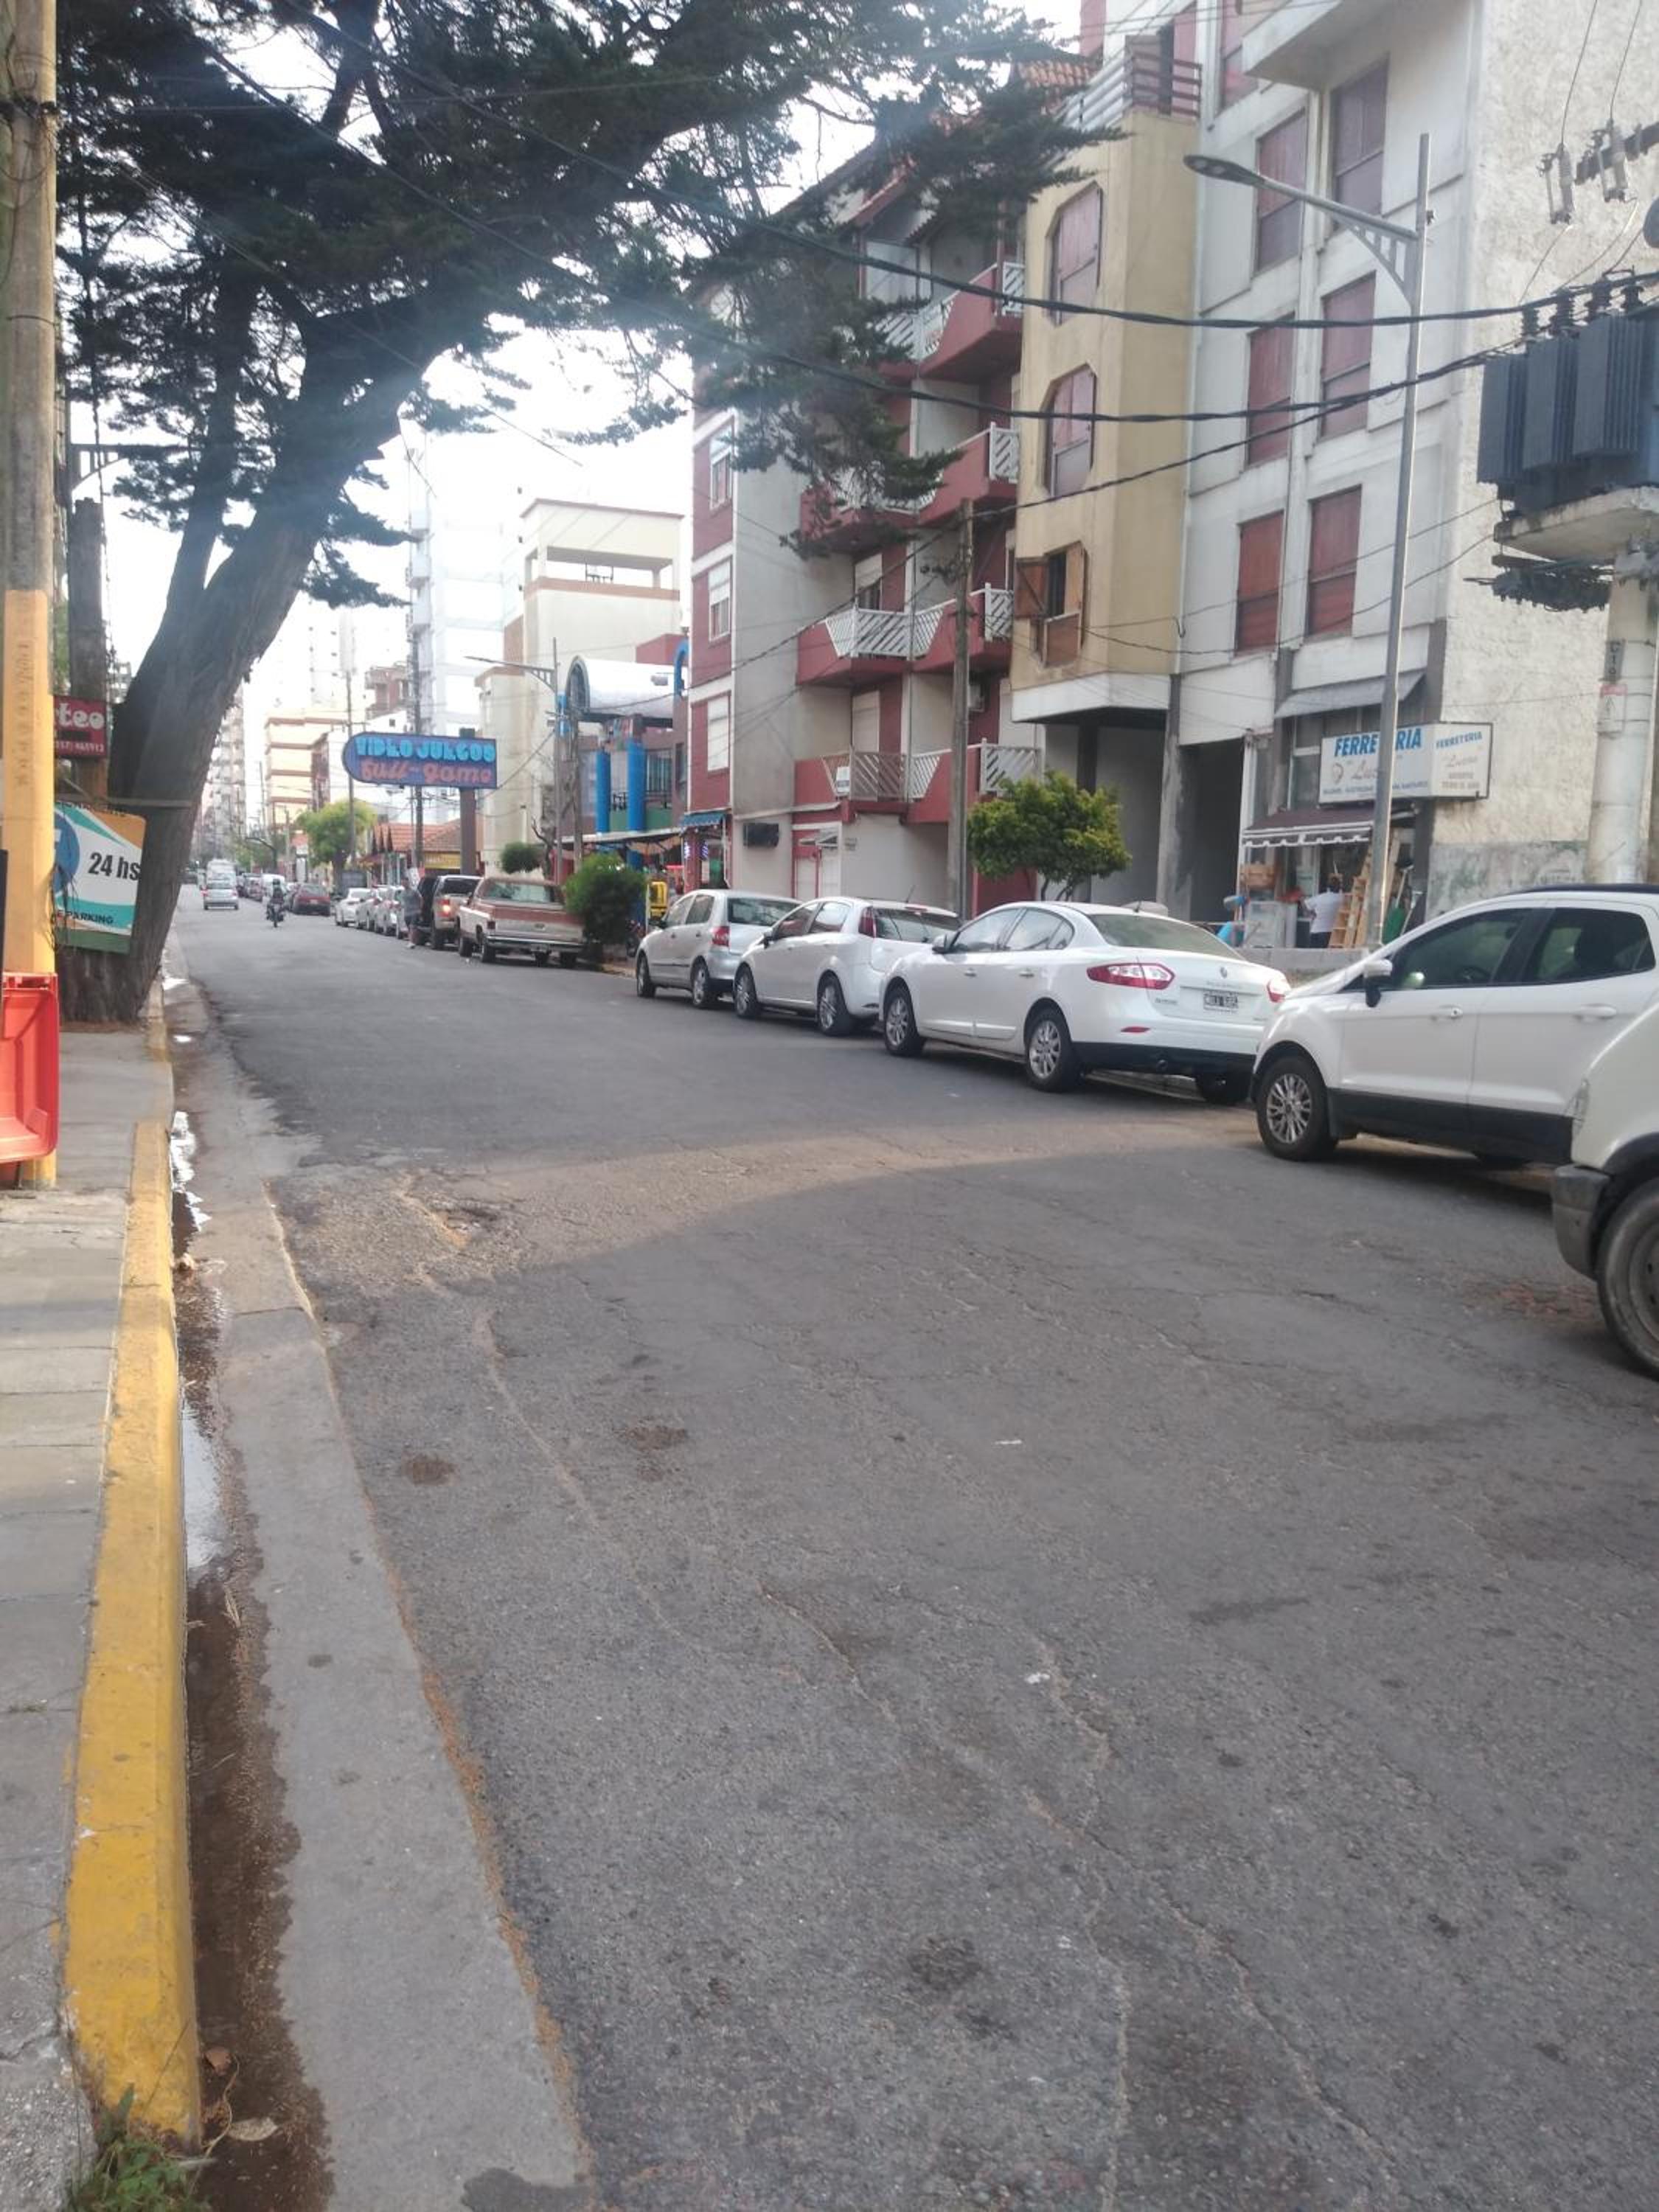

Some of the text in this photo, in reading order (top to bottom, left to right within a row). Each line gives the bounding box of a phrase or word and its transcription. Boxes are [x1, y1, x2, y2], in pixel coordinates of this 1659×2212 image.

[355, 737, 496, 763] VIDEO JUEGOS
[1436, 731, 1483, 748] FERRETERIA
[88, 852, 142, 881] 24 hs
[66, 911, 114, 924] PARKING
